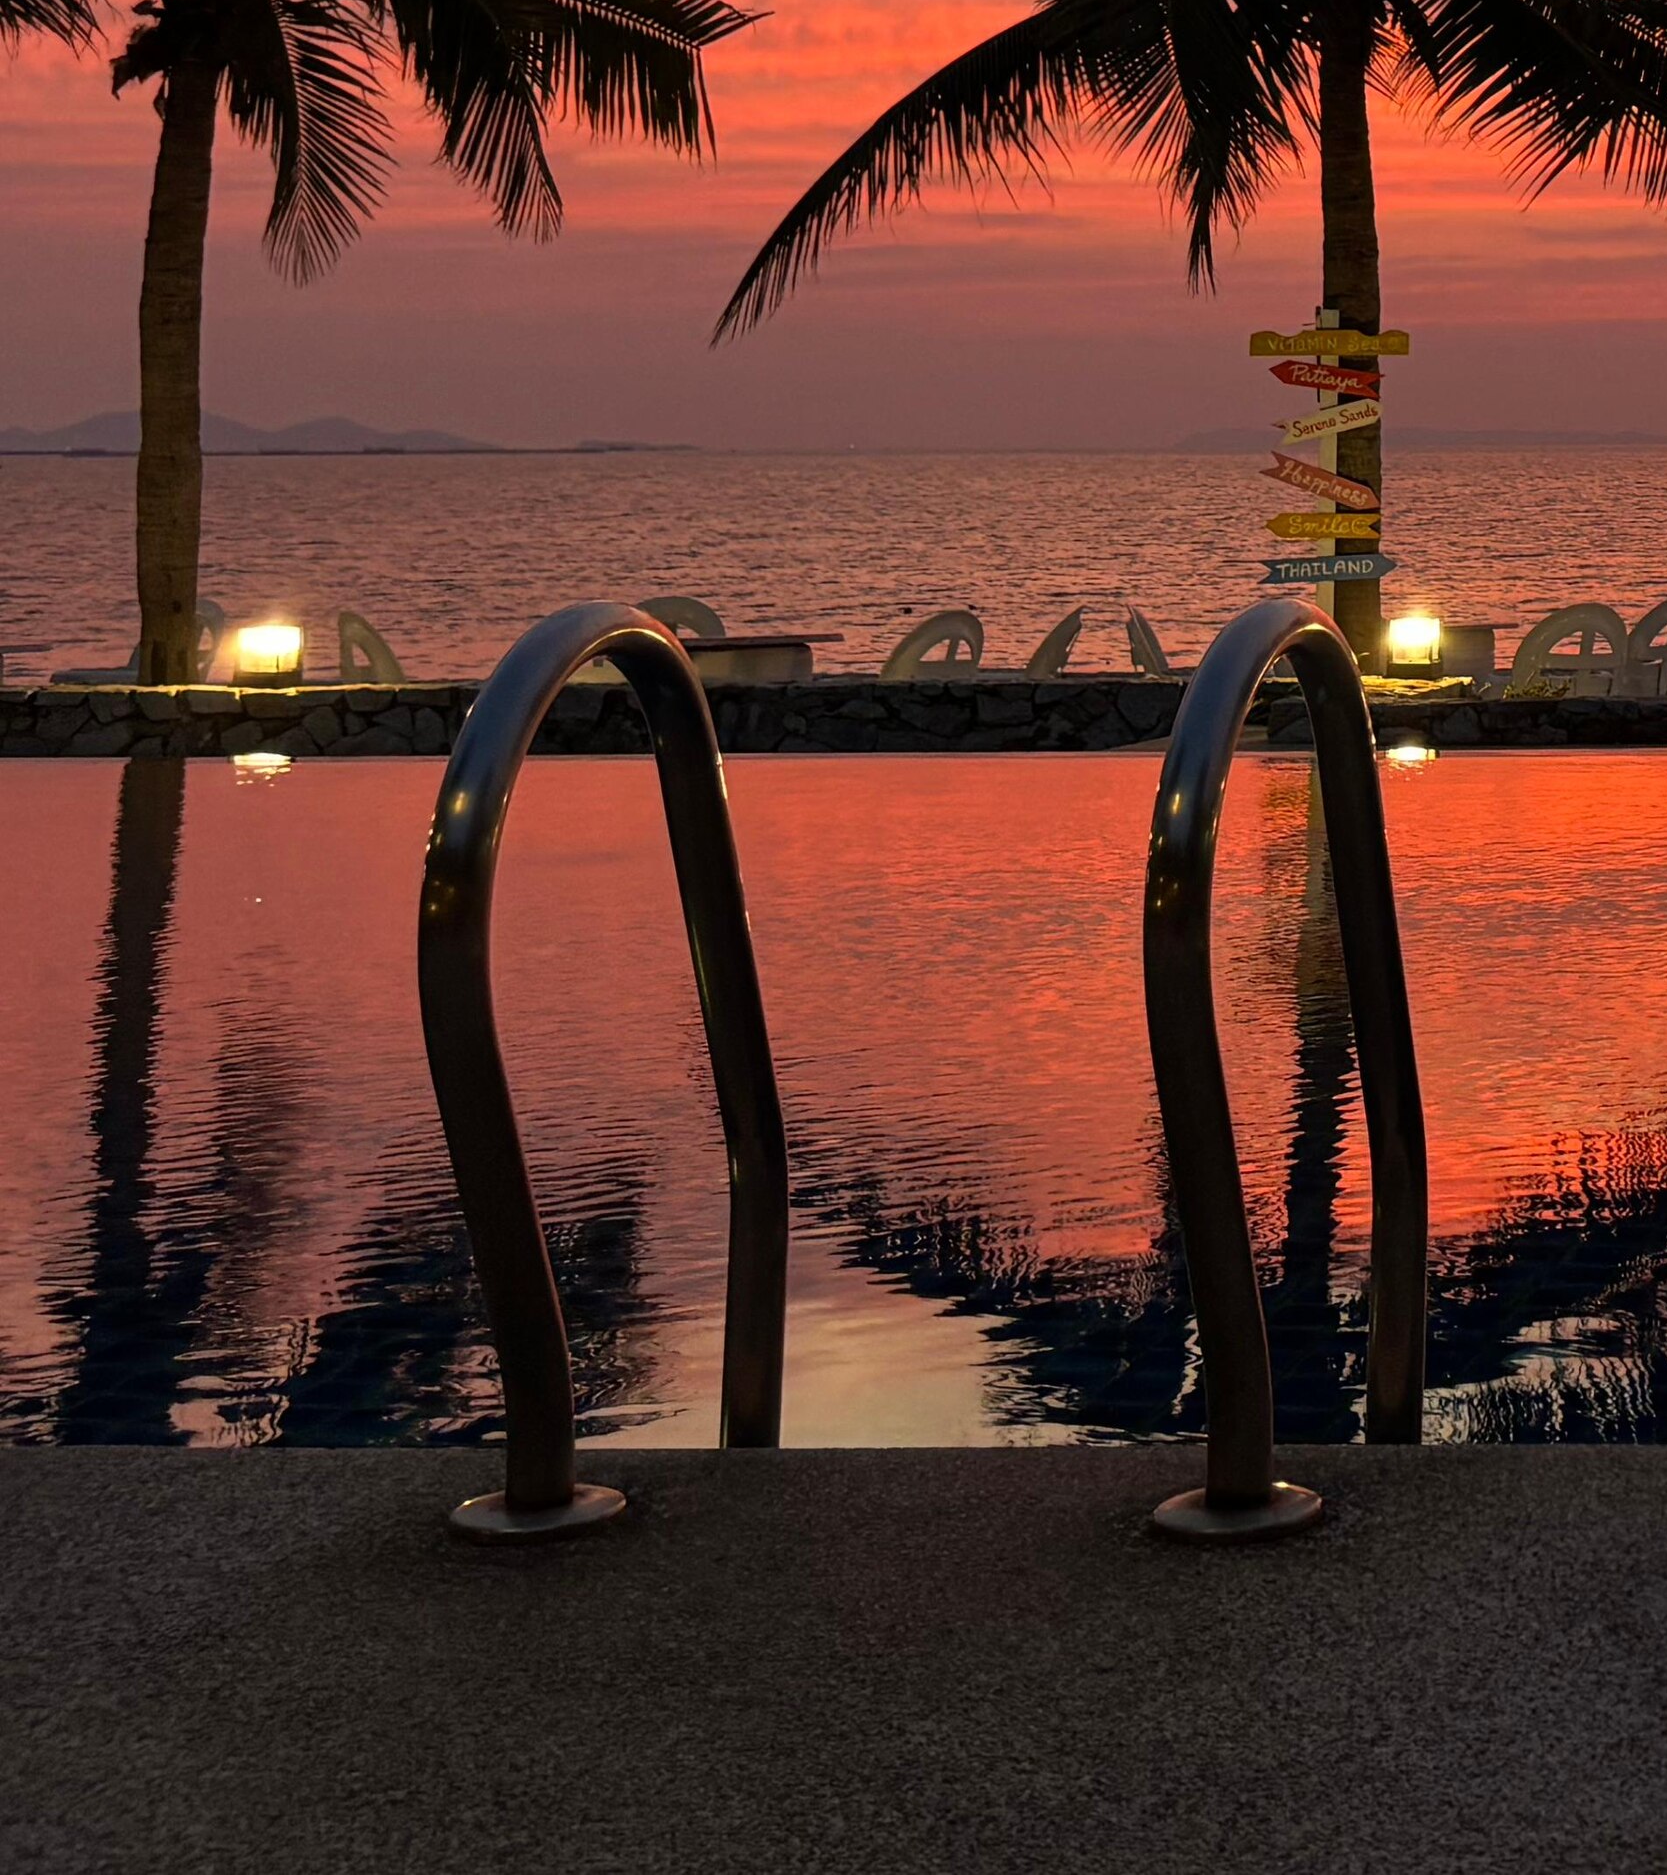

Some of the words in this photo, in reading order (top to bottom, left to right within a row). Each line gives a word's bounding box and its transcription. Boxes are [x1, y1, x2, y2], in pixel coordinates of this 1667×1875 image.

[1289, 364, 1363, 393] Pattaya
[1339, 404, 1379, 424] Sands
[1280, 460, 1368, 506] Happiness
[1289, 515, 1350, 534] Smile
[1276, 559, 1374, 579] THAILAND
